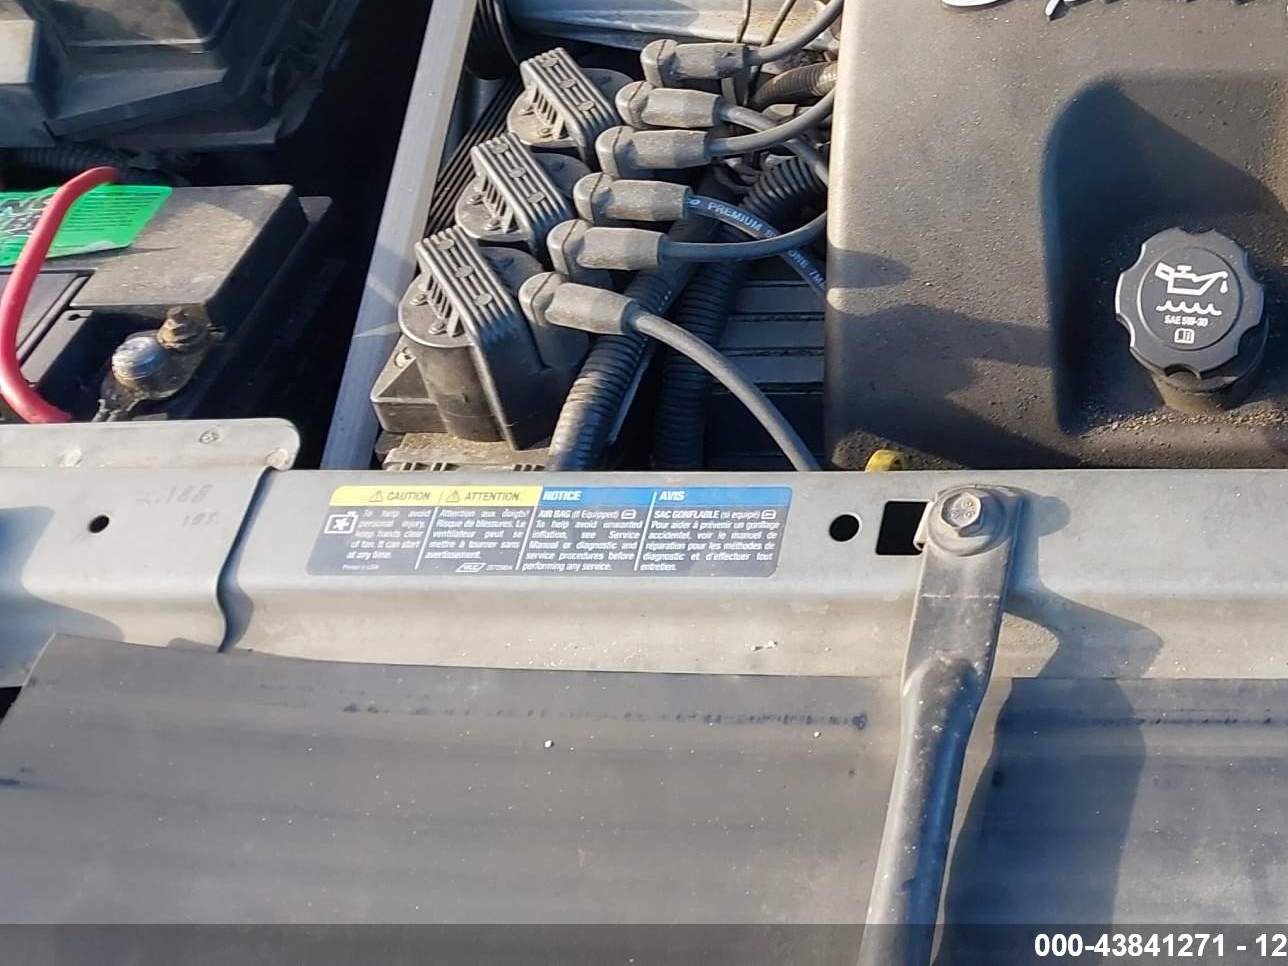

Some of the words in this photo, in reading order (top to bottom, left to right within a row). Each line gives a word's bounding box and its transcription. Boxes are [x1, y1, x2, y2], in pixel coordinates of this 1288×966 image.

[707, 201, 762, 232] PREMIUM
[1164, 314, 1180, 325] SAE
[1181, 316, 1209, 327] 5W-30
[386, 491, 431, 501] CAUTION
[464, 491, 520, 501] ATTENTION
[542, 490, 582, 501] NOTICE
[658, 490, 686, 501] AVIS
[440, 509, 476, 517] Attention
[538, 509, 553, 518] AIR
[553, 509, 571, 518] BAG
[654, 510, 672, 519] SAC
[672, 510, 721, 519] GONFLABLE
